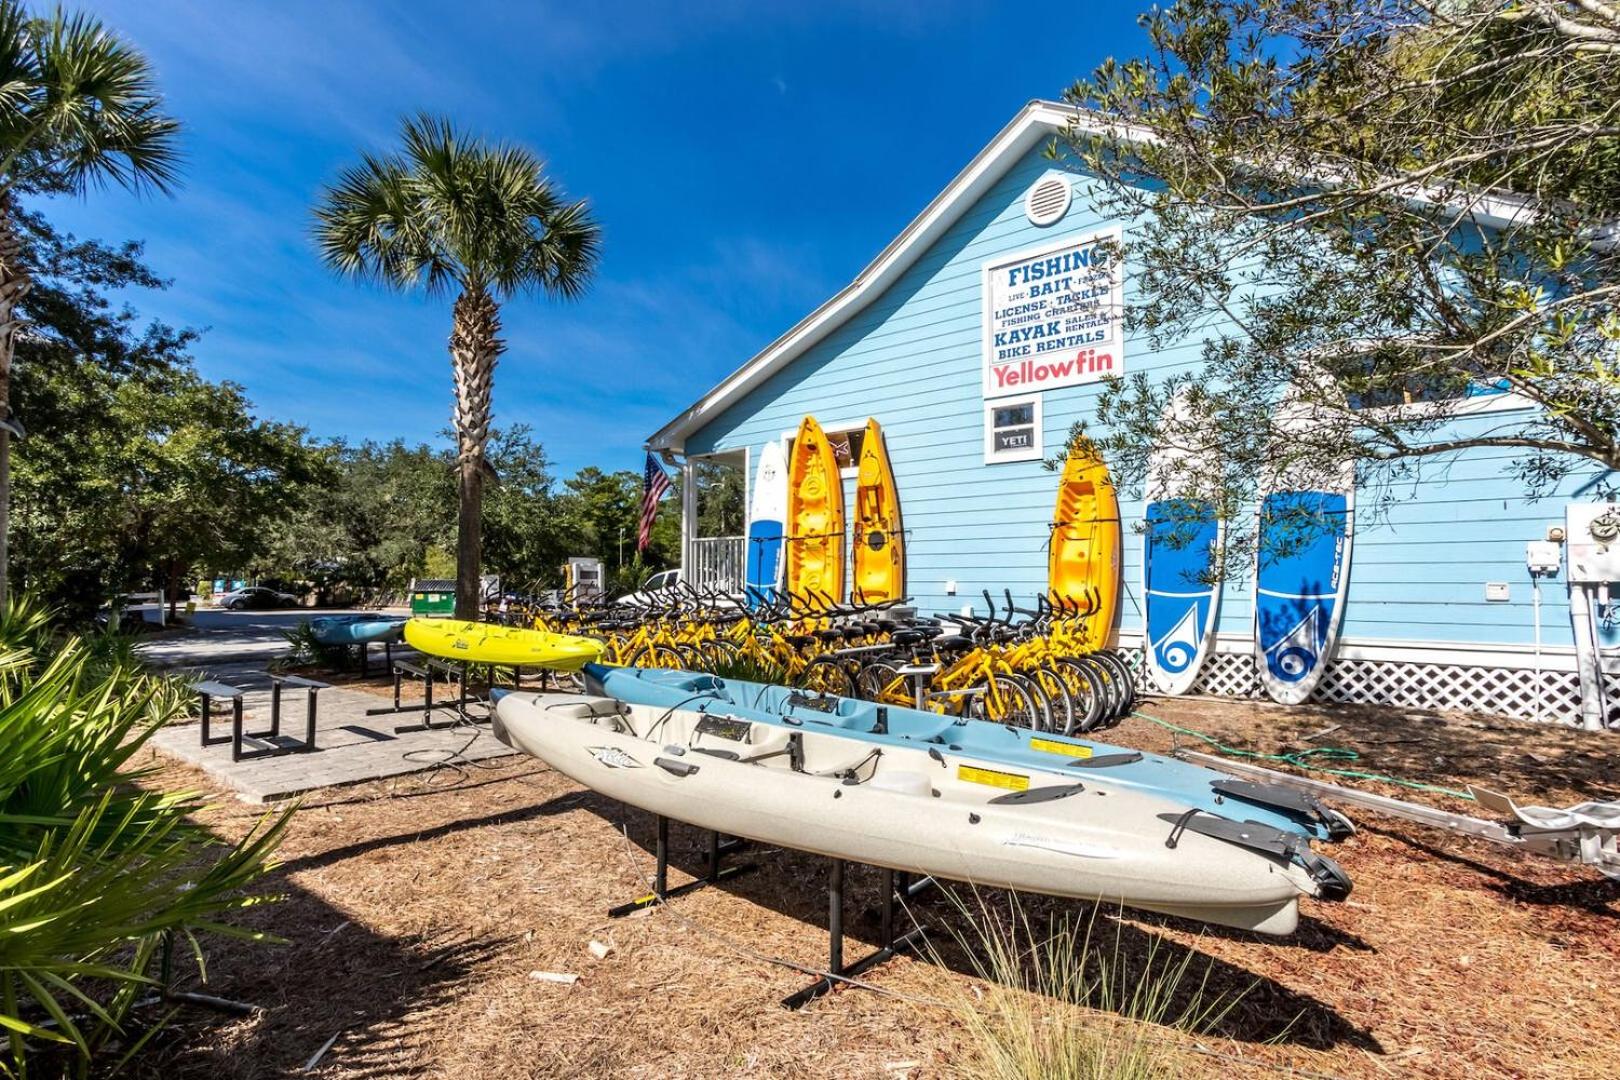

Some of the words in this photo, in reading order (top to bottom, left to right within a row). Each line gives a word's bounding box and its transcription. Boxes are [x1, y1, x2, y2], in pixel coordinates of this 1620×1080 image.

[1008, 244, 1109, 287] FISHING
[1008, 292, 1025, 302] LIVE
[1029, 276, 1073, 298] BAIT
[995, 300, 1047, 320] LICENSE
[1056, 285, 1109, 305] TACKLE
[1002, 312, 1041, 328] FISHING
[1065, 318, 1110, 333] RENTALS
[994, 321, 1061, 347] KAYAK
[999, 344, 1031, 360] BIKE
[1037, 330, 1105, 352] RENTALS
[994, 349, 1113, 388] Yellowfin
[1002, 435, 1027, 446] YETI
